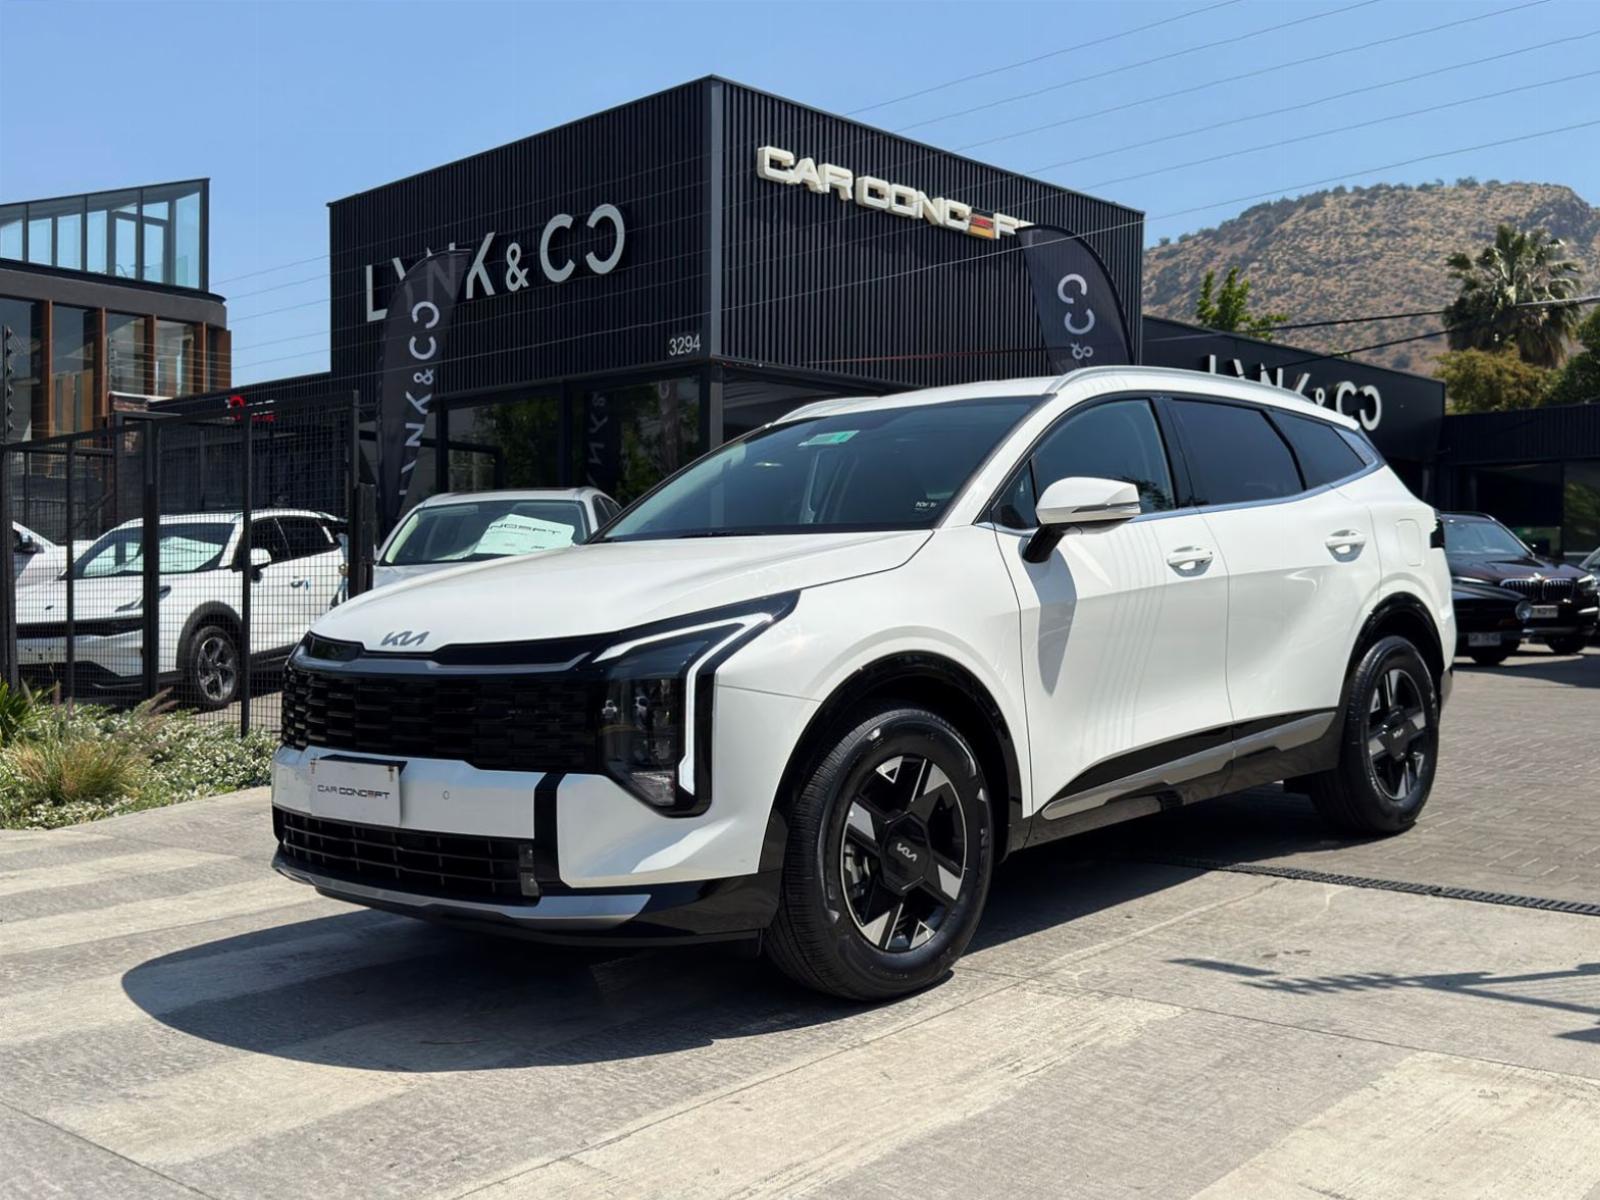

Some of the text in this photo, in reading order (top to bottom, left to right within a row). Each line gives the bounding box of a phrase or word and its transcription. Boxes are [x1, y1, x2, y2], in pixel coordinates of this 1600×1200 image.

[757, 145, 853, 201] CAR
[668, 333, 701, 357] 3294
[317, 784, 391, 799] CAR CONCEPT
